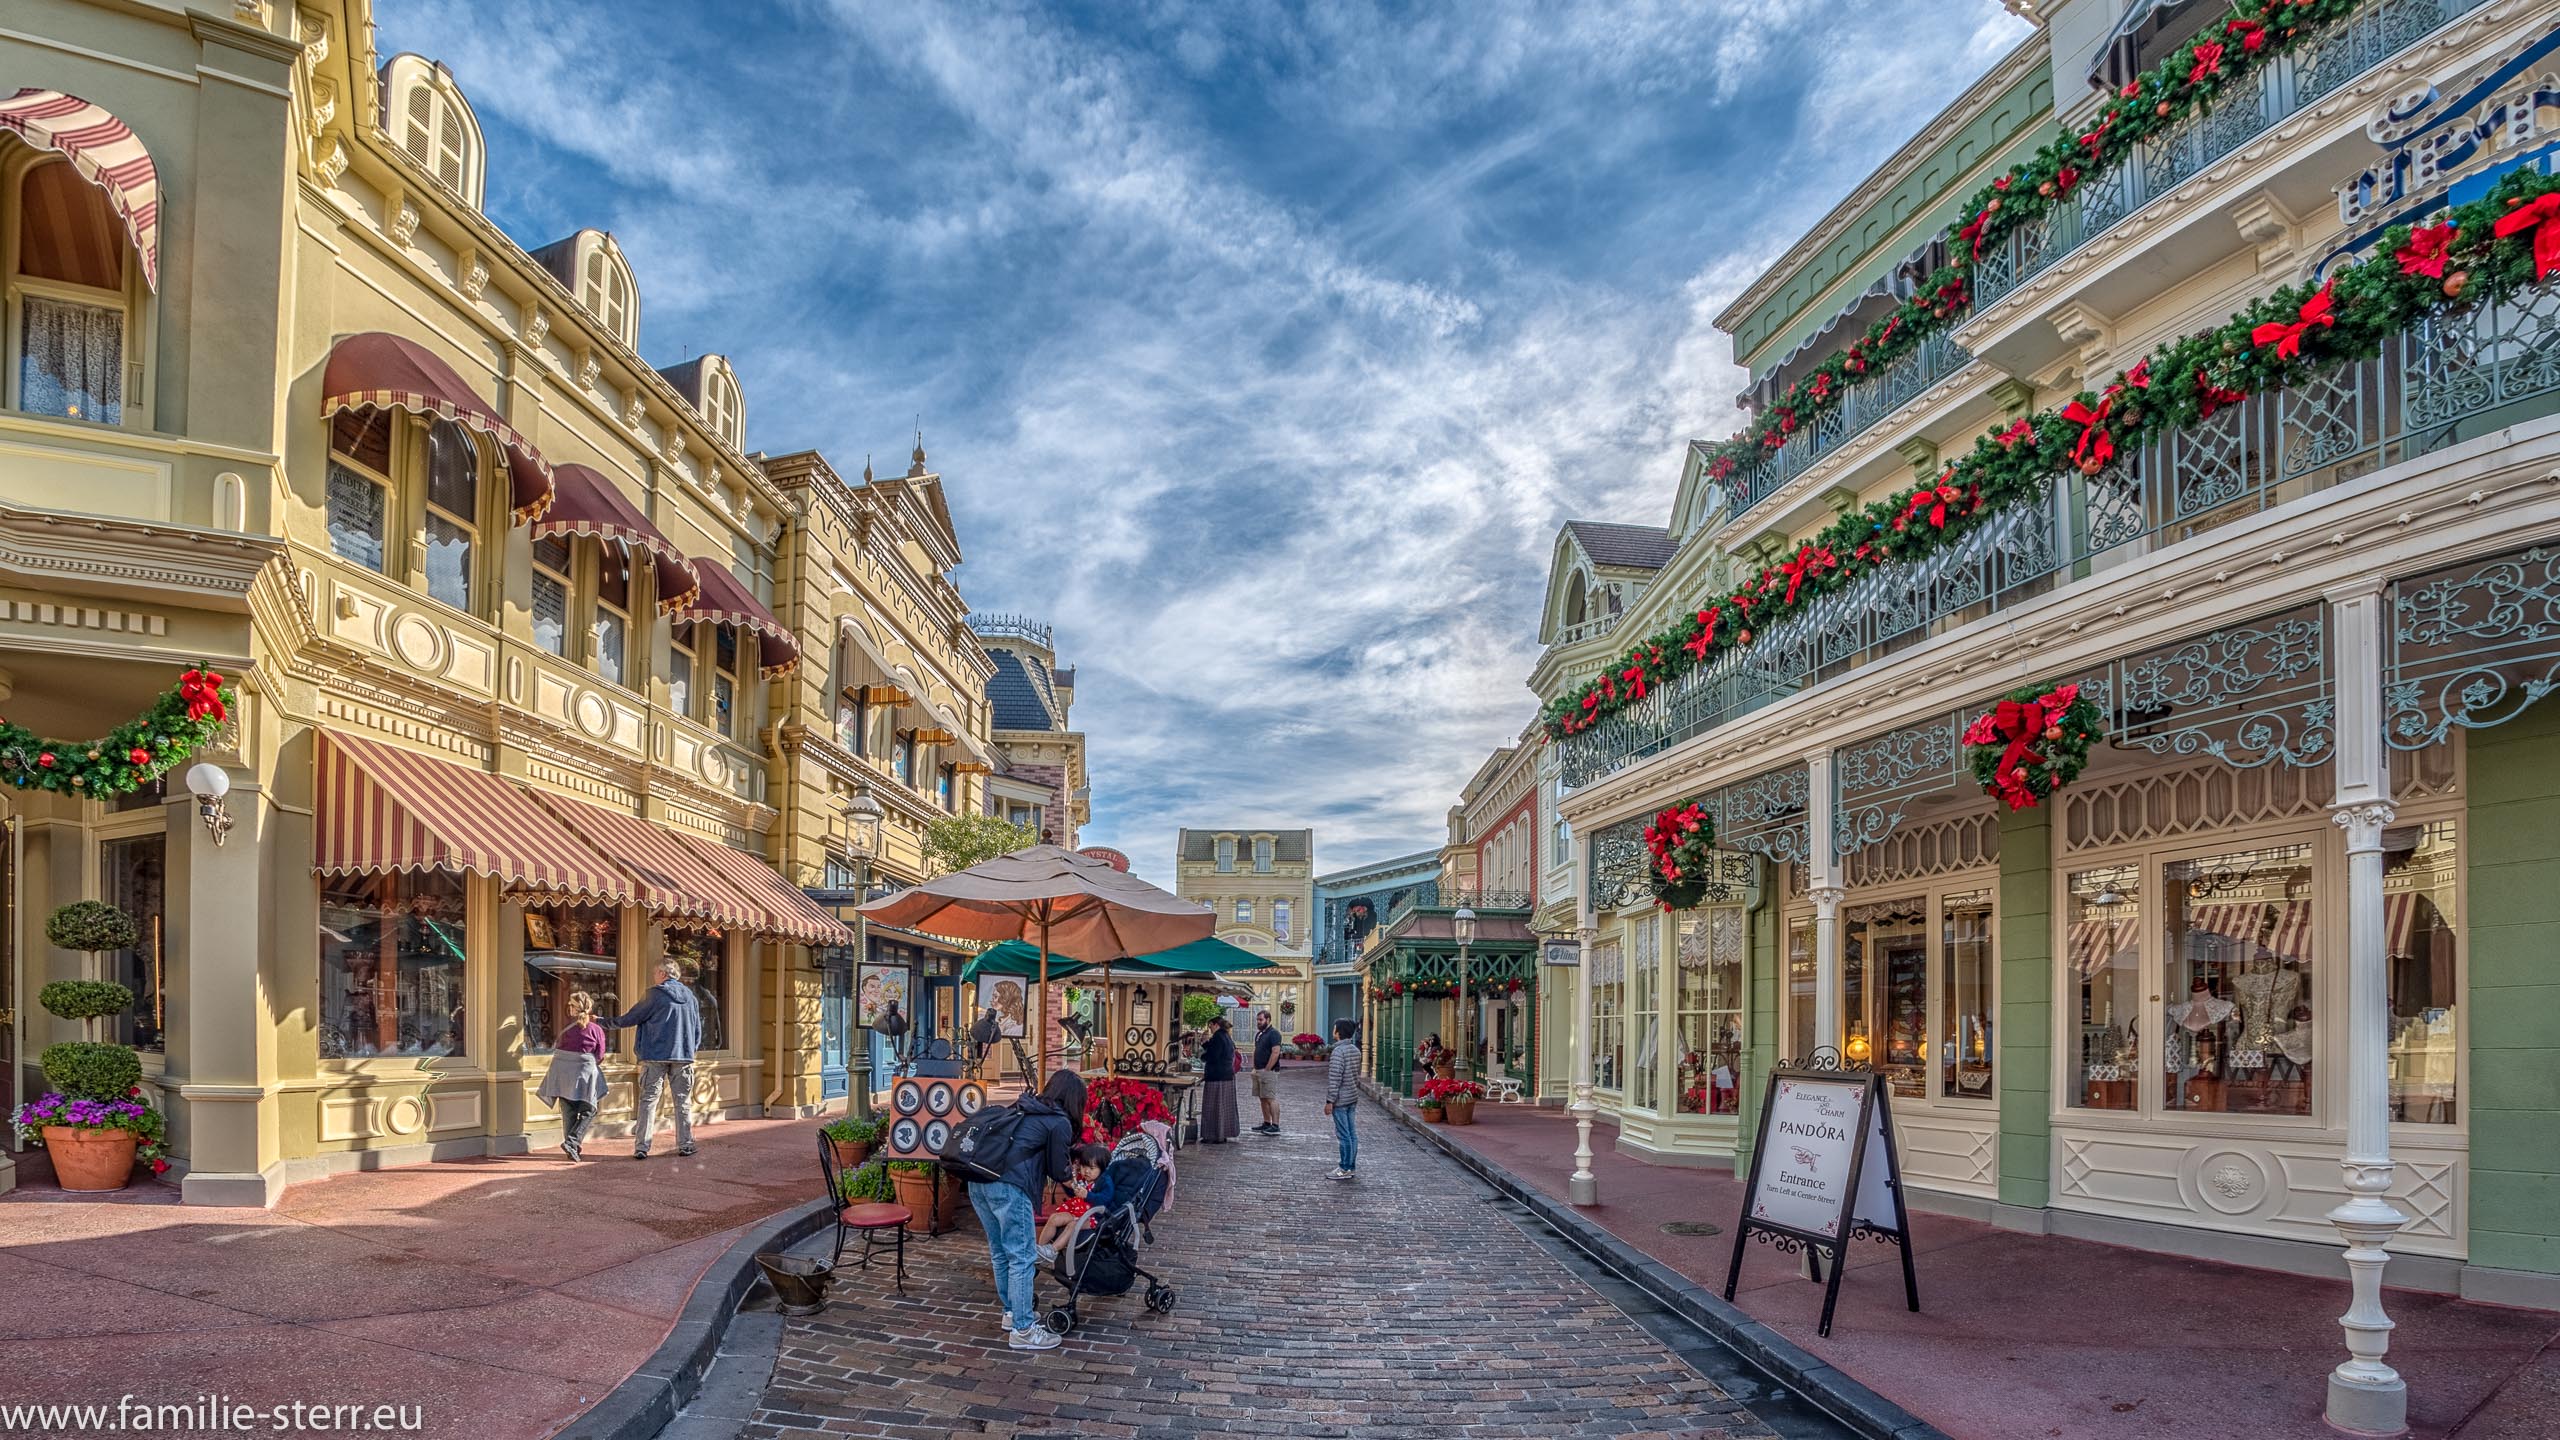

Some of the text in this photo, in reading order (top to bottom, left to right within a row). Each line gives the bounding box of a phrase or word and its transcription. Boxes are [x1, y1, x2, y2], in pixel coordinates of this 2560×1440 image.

[1084, 850, 1118, 862] RYSTAL
[1796, 1092, 1828, 1102] ELEGANCE
[1820, 1108, 1845, 1118] CHARM
[1779, 1121, 1845, 1141] PANDORA
[1779, 1170, 1826, 1191] Entrance
[1766, 1184, 1779, 1193] Turn
[1780, 1186, 1791, 1195] Left
[1797, 1191, 1816, 1201] Center
[1818, 1195, 1836, 1205] Street
